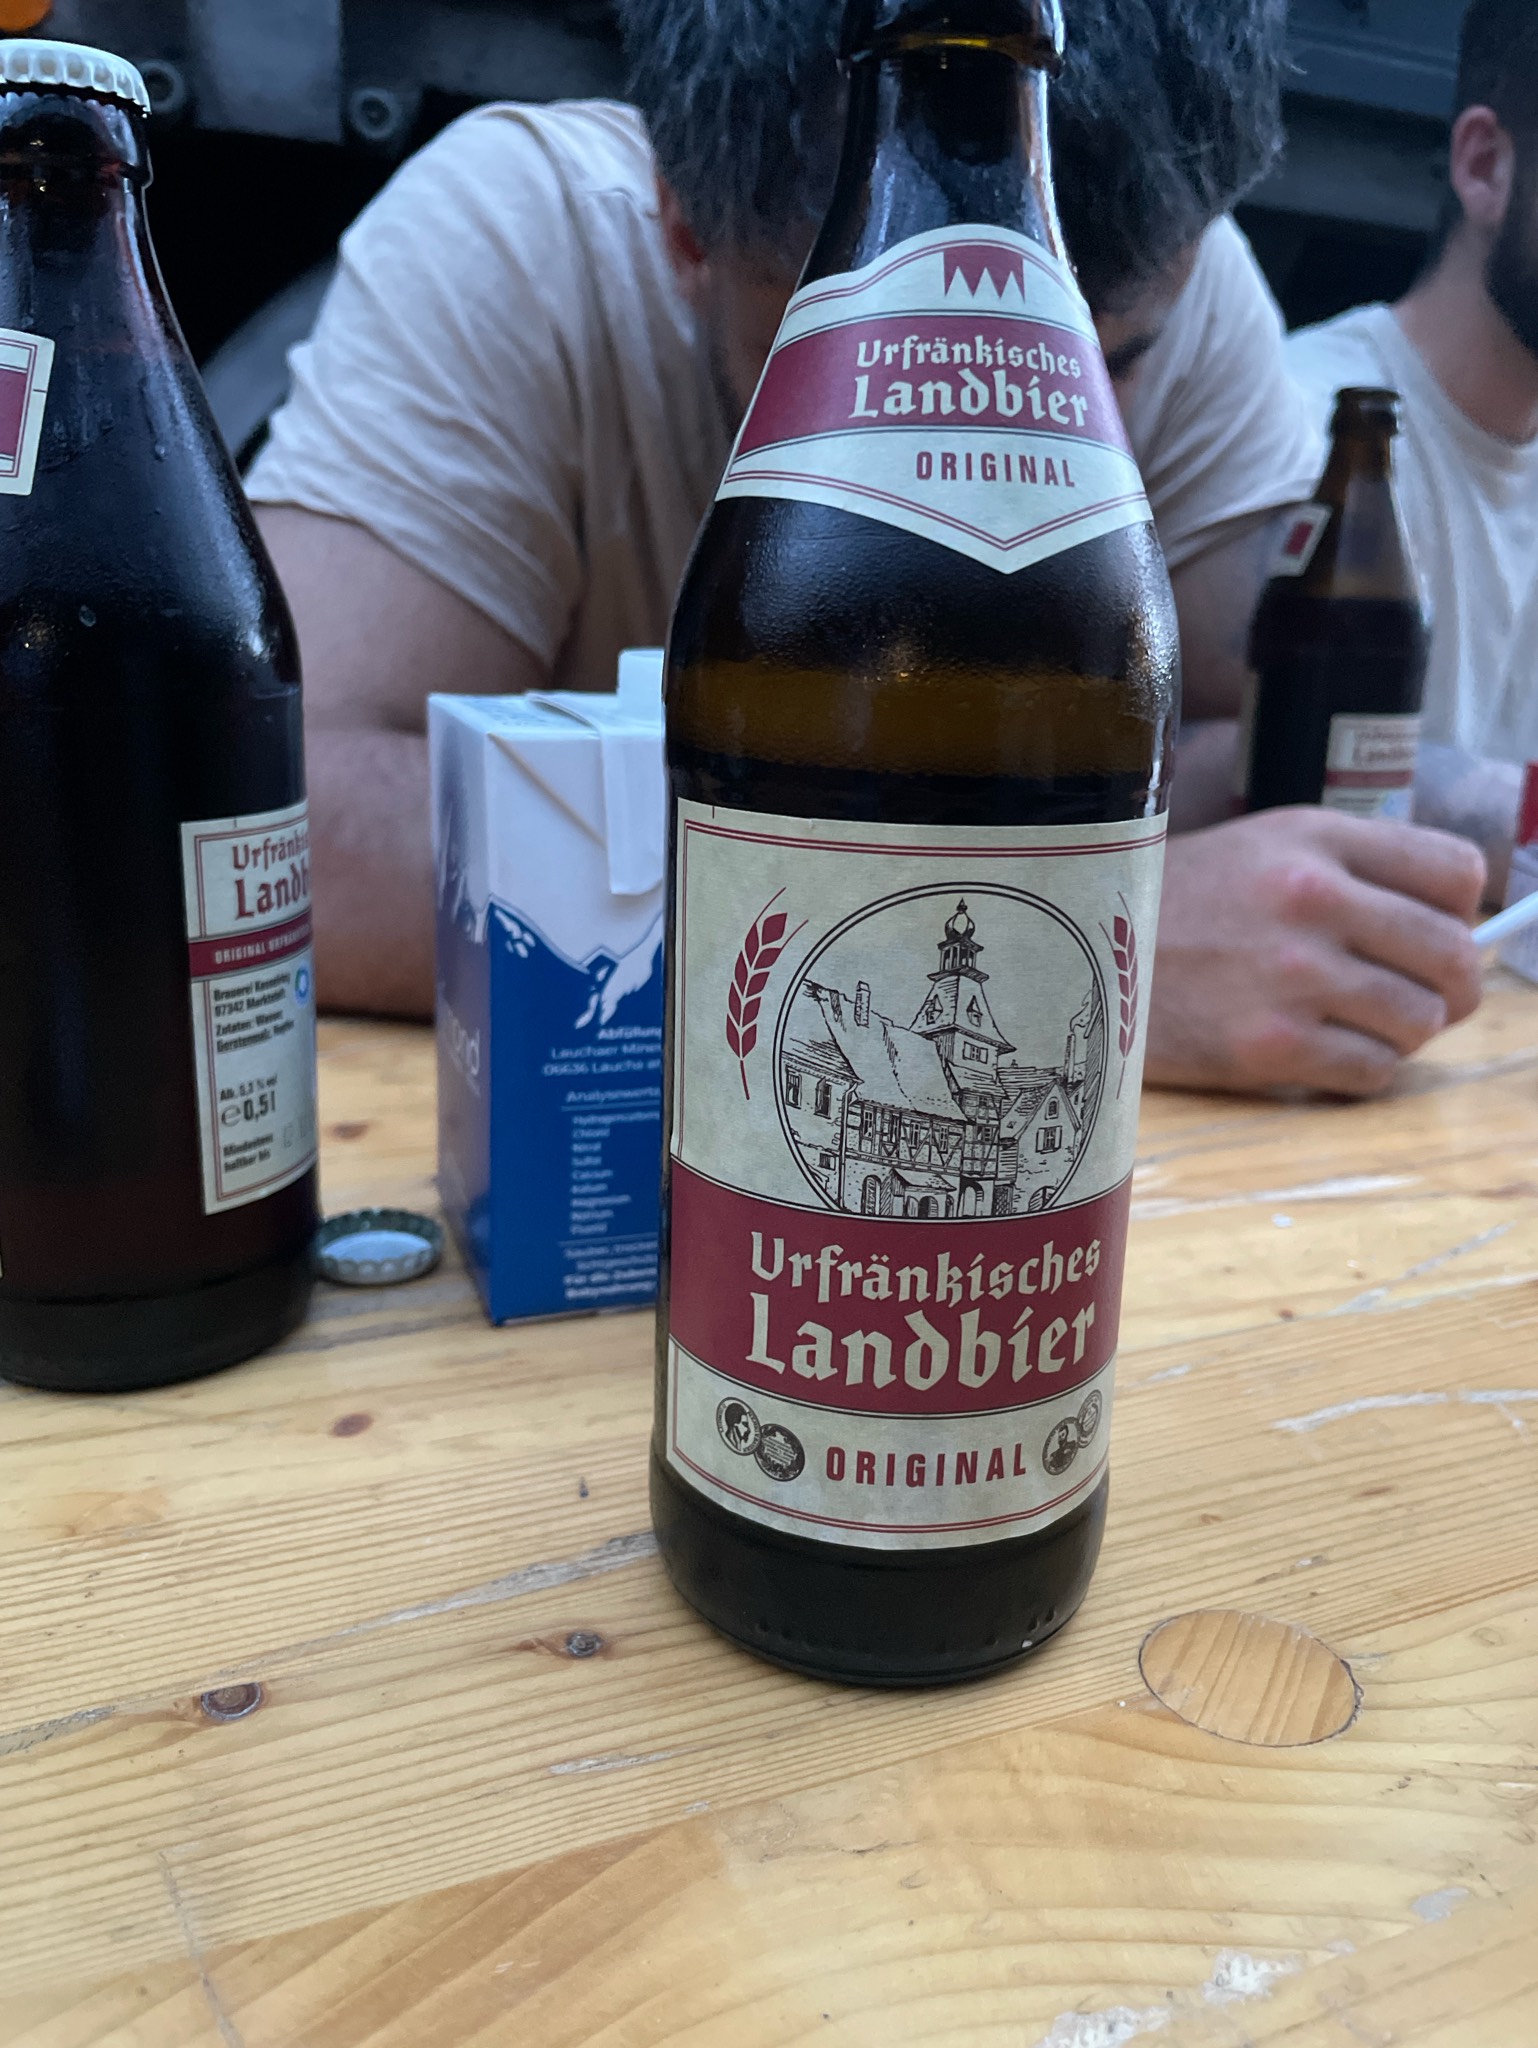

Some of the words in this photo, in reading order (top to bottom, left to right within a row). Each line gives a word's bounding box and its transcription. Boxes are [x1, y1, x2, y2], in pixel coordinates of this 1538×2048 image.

[857, 335, 1081, 379] Urfränkisches
[848, 368, 1089, 428] Landbier
[916, 451, 1076, 488] ORIGINAL
[215, 942, 266, 965] ORIGINAL
[751, 1231, 1101, 1308] Urfränkisches
[745, 1292, 1096, 1391] Landbier
[826, 1443, 1027, 1488] ORIGINAL
